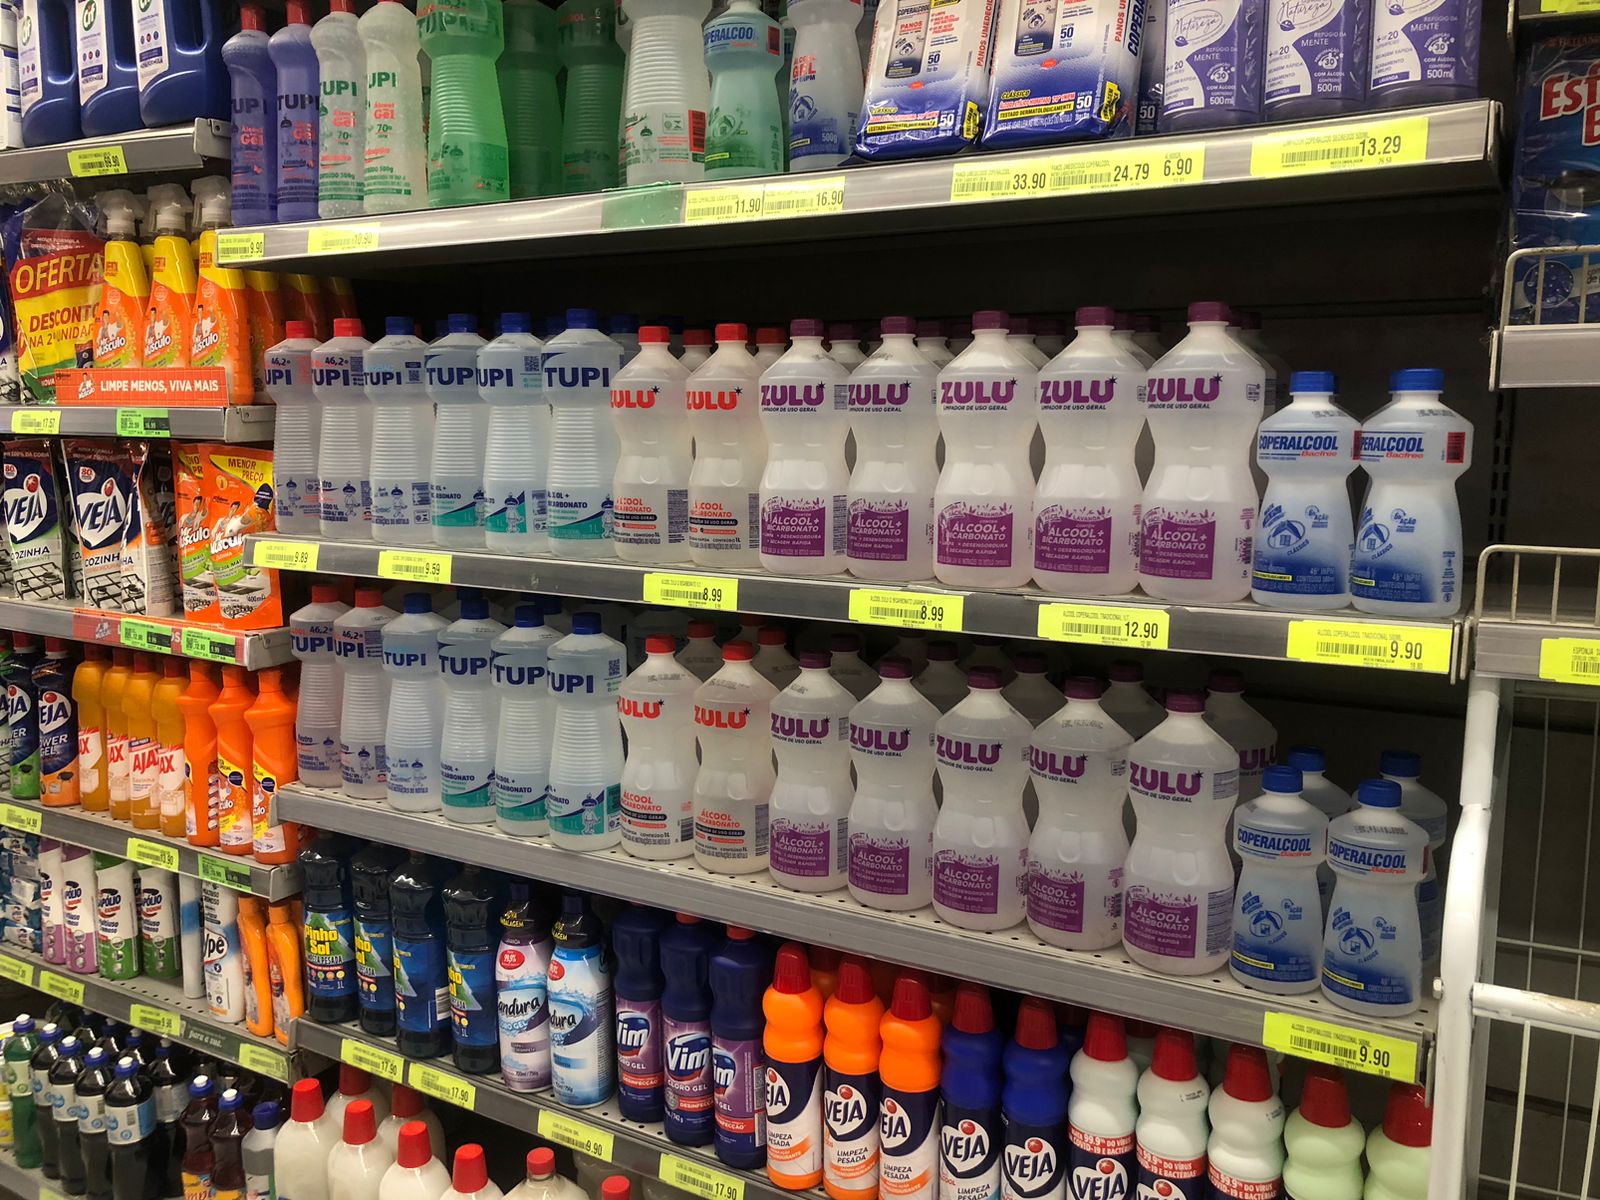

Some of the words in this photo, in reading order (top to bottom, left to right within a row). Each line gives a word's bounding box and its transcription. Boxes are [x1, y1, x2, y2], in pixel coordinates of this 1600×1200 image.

[1060, 27, 1074, 38] 50
[1411, 23, 1439, 32] MENTE
[1301, 39, 1328, 47] MENTE
[1388, 31, 1399, 40] 20
[1193, 53, 1219, 62] MENTE
[1279, 46, 1290, 55] 20
[928, 54, 940, 64] 50
[793, 62, 816, 79] GEL
[1076, 96, 1092, 108] 50
[374, 110, 395, 120] Gel
[939, 114, 954, 126] 50
[1360, 136, 1401, 157] 13.29
[1113, 163, 1150, 181] 24.79
[1163, 158, 1192, 176] 6.90
[1012, 173, 1046, 190] 33.90
[735, 198, 761, 213] 11.90
[816, 191, 843, 206] 16.90
[249, 241, 263, 254] 9.90
[16, 252, 104, 295] OFERTA
[30, 335, 44, 349] NA
[363, 371, 402, 386] TUPI
[544, 367, 610, 387] TUPI
[101, 380, 129, 392] LIMPE
[130, 380, 167, 393] MENOS,
[169, 380, 193, 392] VIVA
[195, 380, 219, 392] MAIS
[848, 383, 909, 405] ZULU
[941, 381, 1015, 404] ZULU
[1040, 380, 1114, 404] ZULU
[1148, 378, 1221, 403] ZULU
[761, 384, 825, 406] ZULU
[1259, 434, 1339, 451] COPERALCOOL
[228, 458, 256, 470] MENOR
[242, 470, 264, 482] PREÇO
[4, 494, 43, 529] VEJA
[78, 493, 122, 534] VEJA
[294, 551, 308, 563] 9.89
[425, 562, 440, 575] 9.59
[703, 588, 722, 602] 8.99
[920, 605, 944, 622] 8.99
[1124, 622, 1159, 639] 12.90
[1390, 641, 1423, 660] 9.90
[384, 652, 426, 667] TUPI
[695, 704, 746, 730] ZULU
[770, 713, 829, 739] ZULU
[850, 723, 909, 752] ZULU
[936, 734, 999, 764] ZULU
[1129, 761, 1200, 796] ZULU
[1237, 827, 1312, 852] COPERALCOOL
[1328, 840, 1407, 869] COPERALCOOL
[310, 941, 330, 955] Sol
[667, 1042, 711, 1071] Vim
[1360, 1046, 1390, 1068] 9.90
[381, 1061, 397, 1077] 17.90
[631, 1061, 646, 1070] GEL
[667, 1080, 691, 1092] CLORO
[692, 1083, 708, 1092] GEL
[451, 1087, 469, 1103] 17.90
[718, 1101, 732, 1111] GEL
[825, 1098, 864, 1126] VEJA
[768, 1131, 792, 1142] LIMPEZA
[586, 1139, 602, 1156] 9.90
[837, 1147, 868, 1157] LIMPEZA
[944, 1138, 986, 1165] VEJA
[837, 1155, 866, 1164] PESADA
[1005, 1153, 1053, 1179] VEJA
[1177, 1161, 1192, 1170] VÍRUS
[884, 1165, 912, 1173] LIMPEZA
[884, 1171, 910, 1180] PESADA
[1164, 1168, 1198, 1178] BACTÉRIAS
[714, 1181, 737, 1200] 17.90
[957, 1184, 991, 1195] LIMPEZA
[1076, 1176, 1124, 1200] VEJA
[1255, 1182, 1273, 1191] VÍRUS
[957, 1192, 989, 1200] PESADA
[1245, 1189, 1277, 1200] BACTÉRIAS
